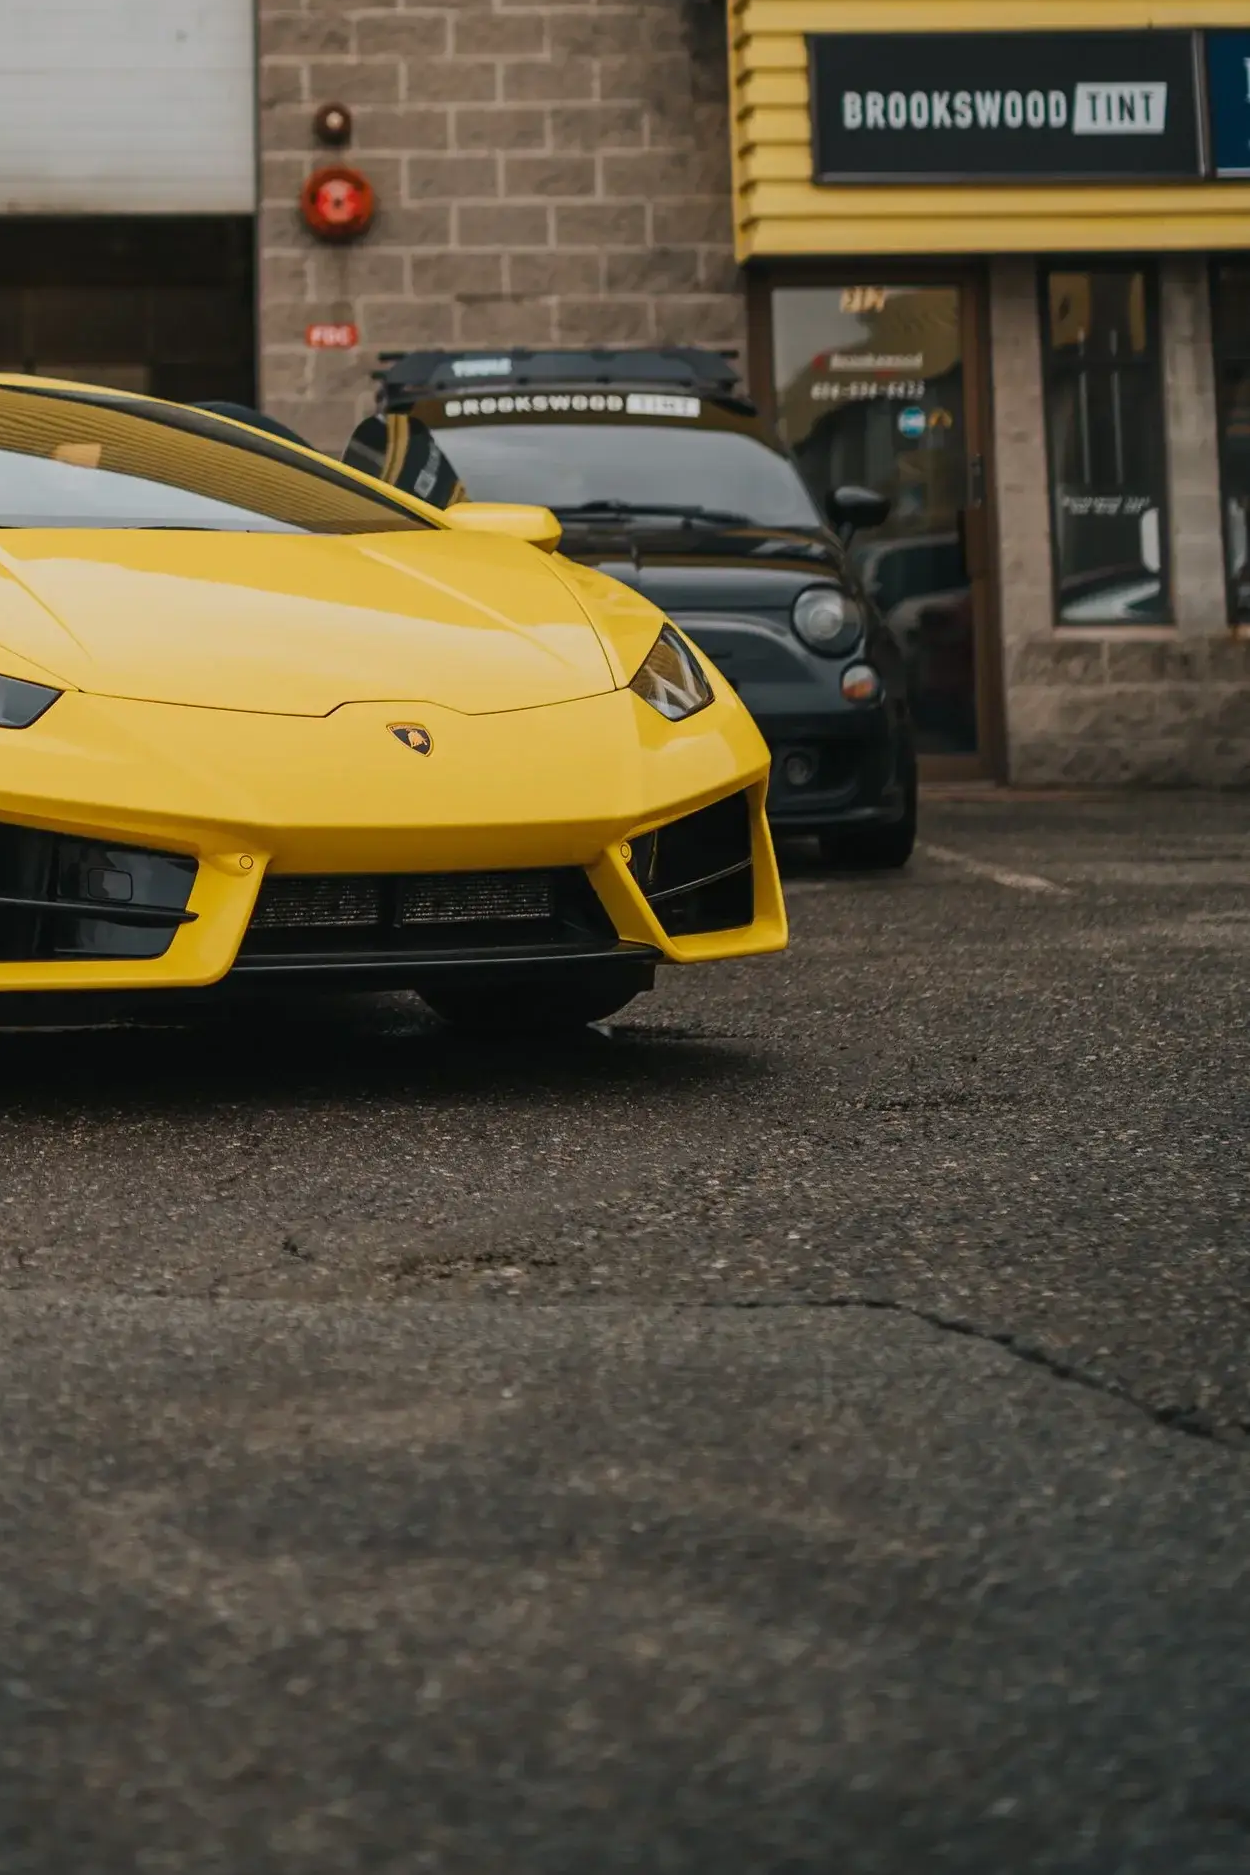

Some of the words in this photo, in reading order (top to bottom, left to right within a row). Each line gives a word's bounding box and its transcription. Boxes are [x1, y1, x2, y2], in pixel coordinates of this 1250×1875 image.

[843, 89, 1067, 130] BROOKSWOOD
[1085, 90, 1156, 127] TINT
[445, 394, 623, 417] BROOKSWOOD
